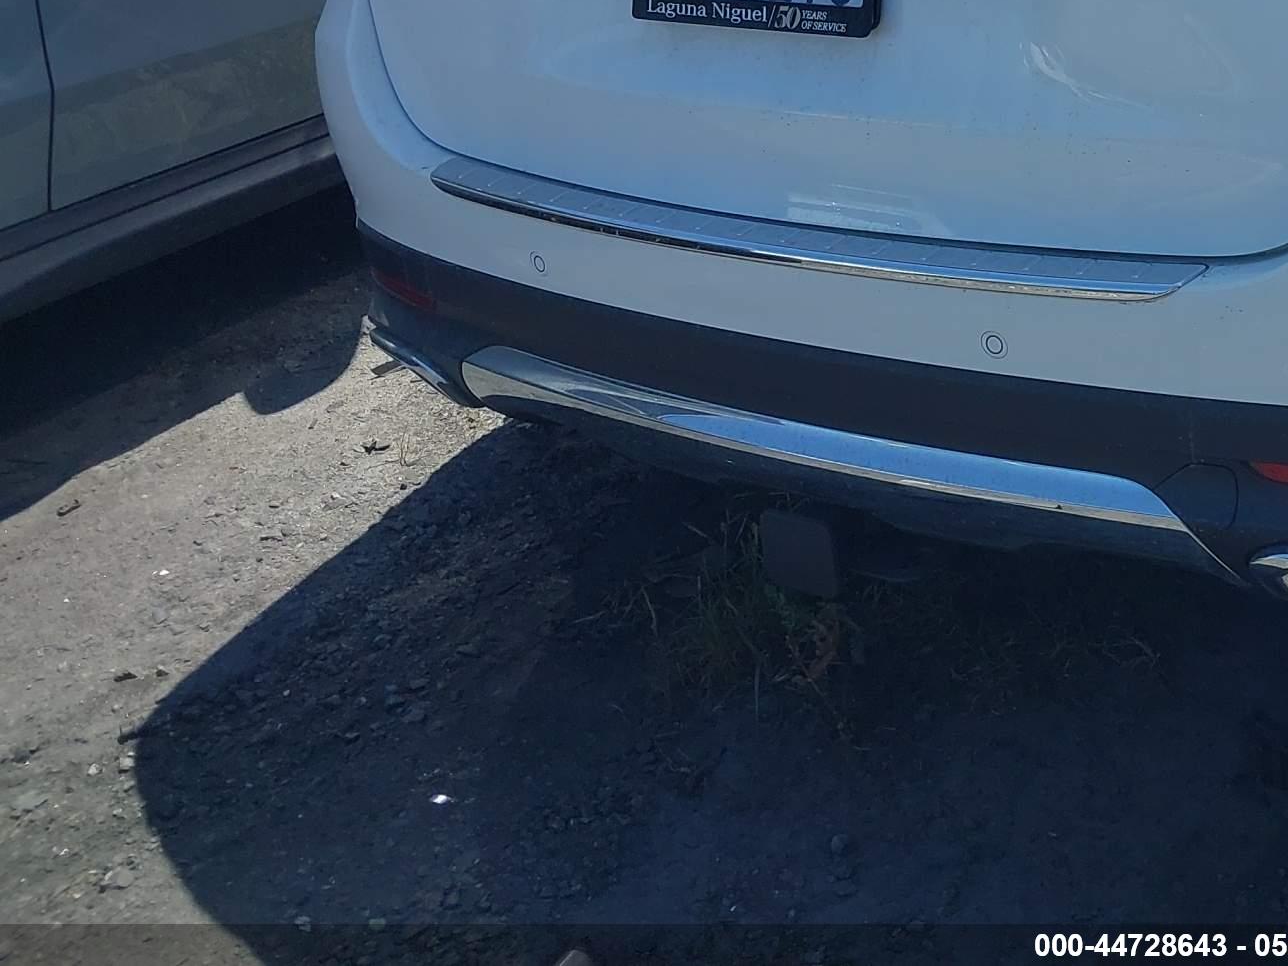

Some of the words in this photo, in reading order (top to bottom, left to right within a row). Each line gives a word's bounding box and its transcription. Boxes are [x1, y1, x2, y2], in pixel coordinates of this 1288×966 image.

[711, 2, 767, 24] Niguel
[774, 5, 801, 30] 50
[801, 10, 828, 21] YEARS
[801, 20, 813, 30] OF
[812, 22, 847, 33] SERVICE
